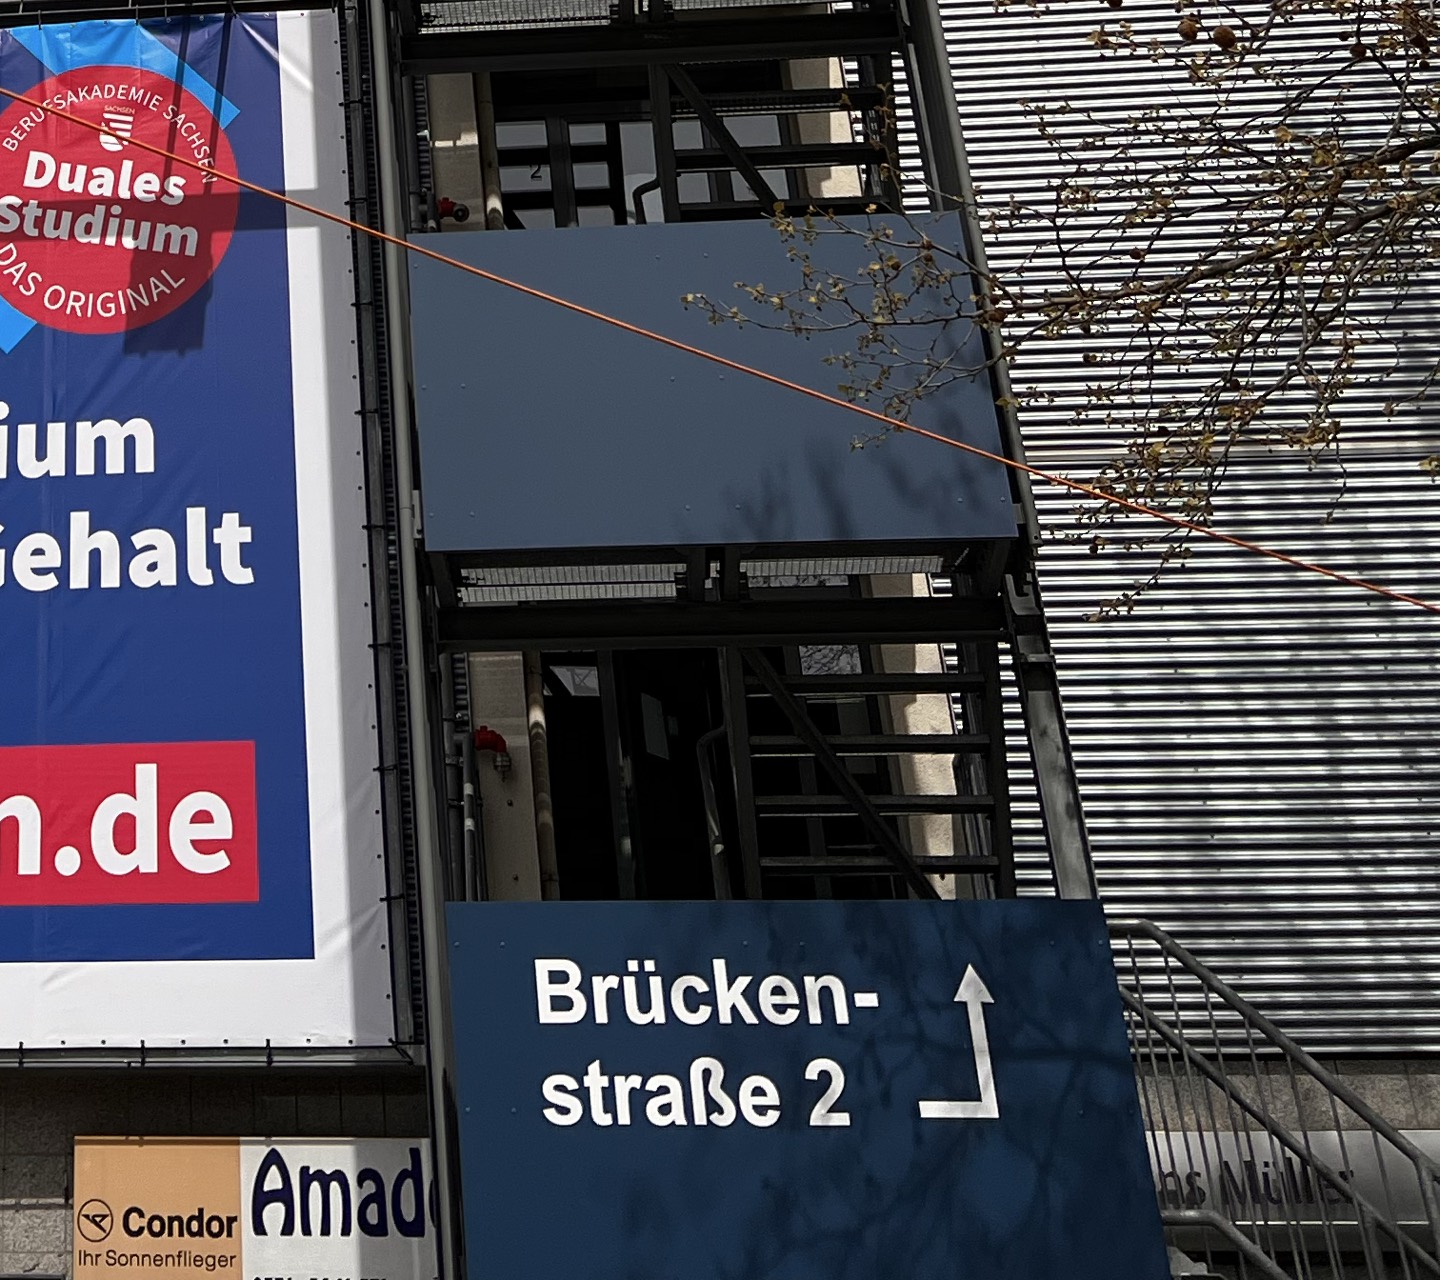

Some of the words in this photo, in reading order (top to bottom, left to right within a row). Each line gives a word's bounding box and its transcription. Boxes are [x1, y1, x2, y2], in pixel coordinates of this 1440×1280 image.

[2, 84, 164, 152] BERUFSAKADEMIE
[162, 104, 218, 184] SACHSEN
[103, 105, 135, 115] SACHSEN
[22, 150, 187, 206] Duales
[43, 269, 186, 318] ORIGINAL
[534, 958, 879, 1026] Brücken-
[541, 1056, 781, 1127] straße
[804, 1058, 850, 1126] 2
[251, 1147, 438, 1239] Amad
[122, 1206, 238, 1239] Condor
[78, 1249, 102, 1267] Ihr
[105, 1249, 237, 1271] Sonnenflieger
